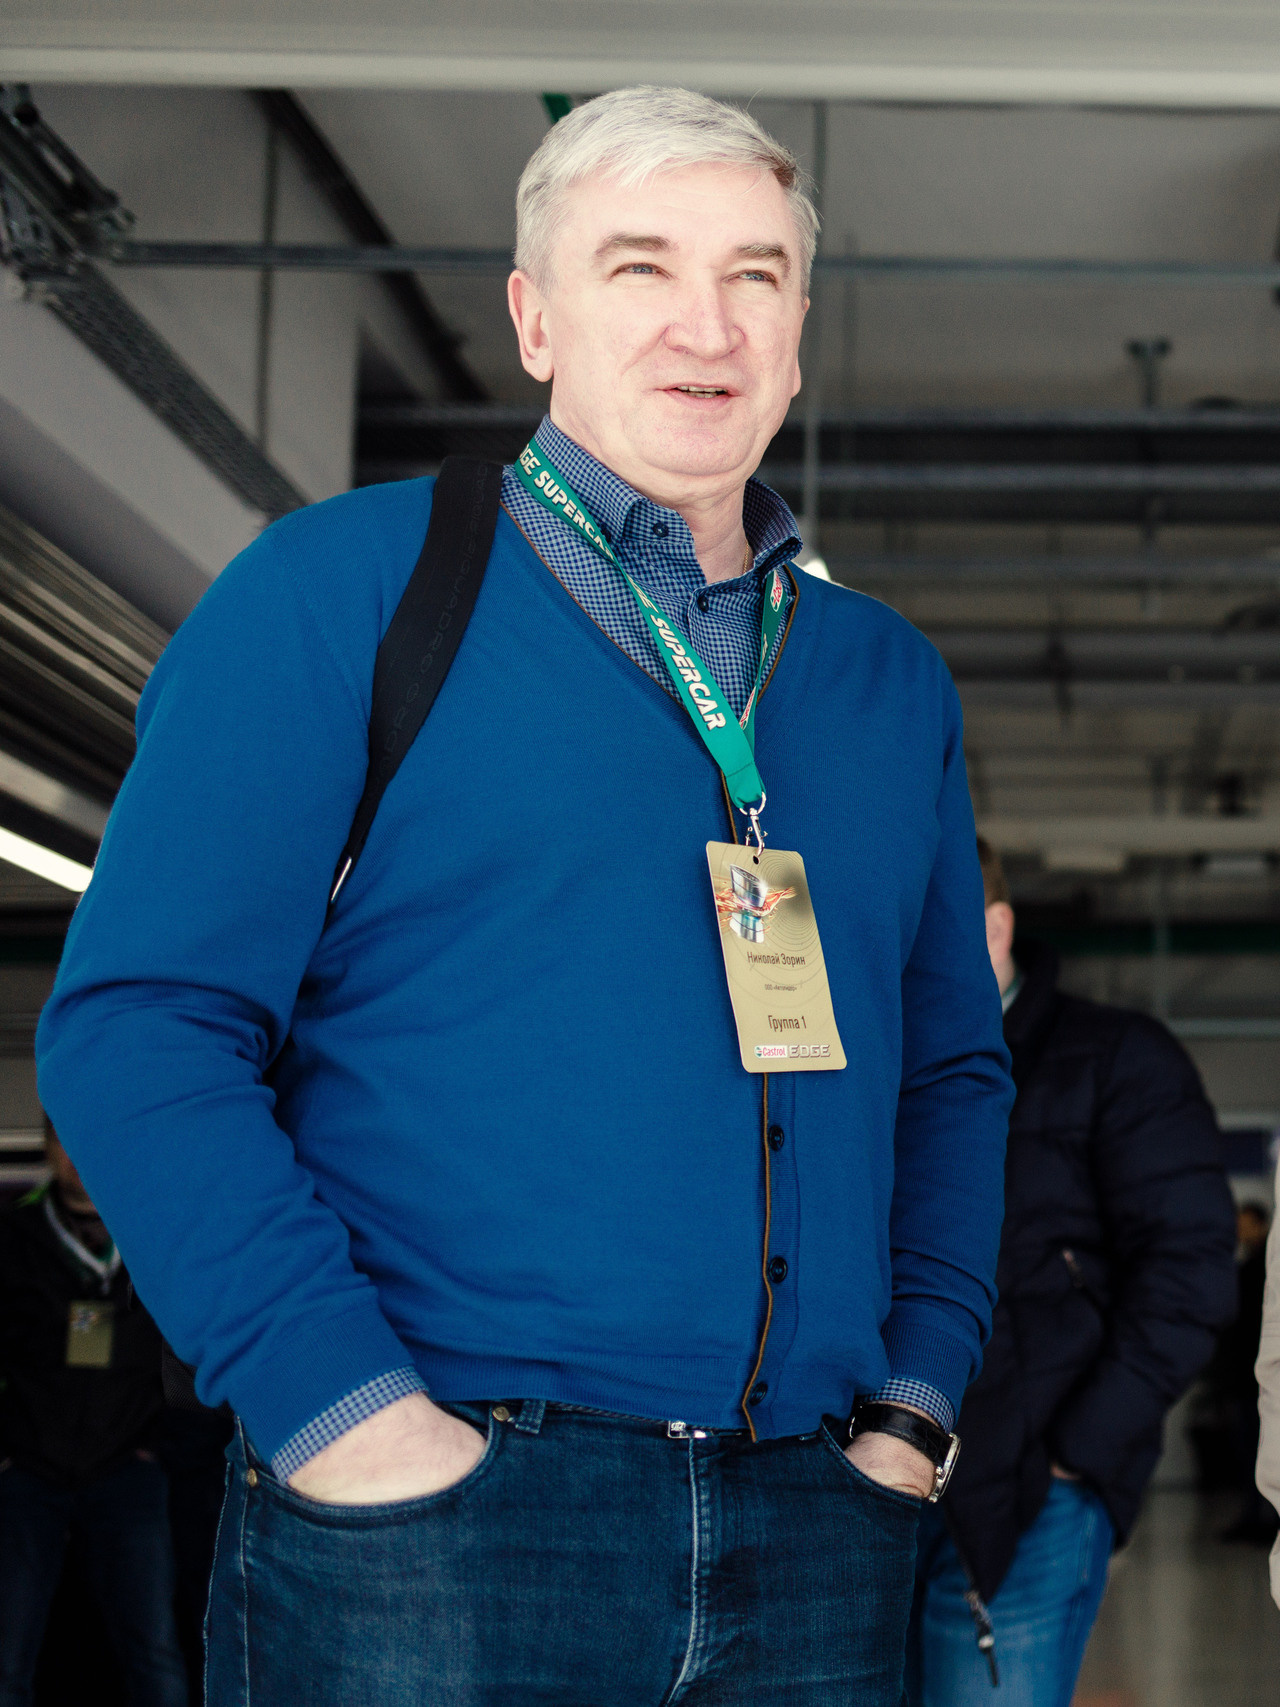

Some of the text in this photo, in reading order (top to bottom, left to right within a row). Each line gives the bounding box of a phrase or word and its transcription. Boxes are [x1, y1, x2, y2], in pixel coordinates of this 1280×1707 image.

[650, 614, 727, 731] SUPERCAR
[747, 951, 806, 967] Николай Зорин
[768, 1015, 807, 1032] Группа 1
[762, 1044, 831, 1058] Castrol EDGE
